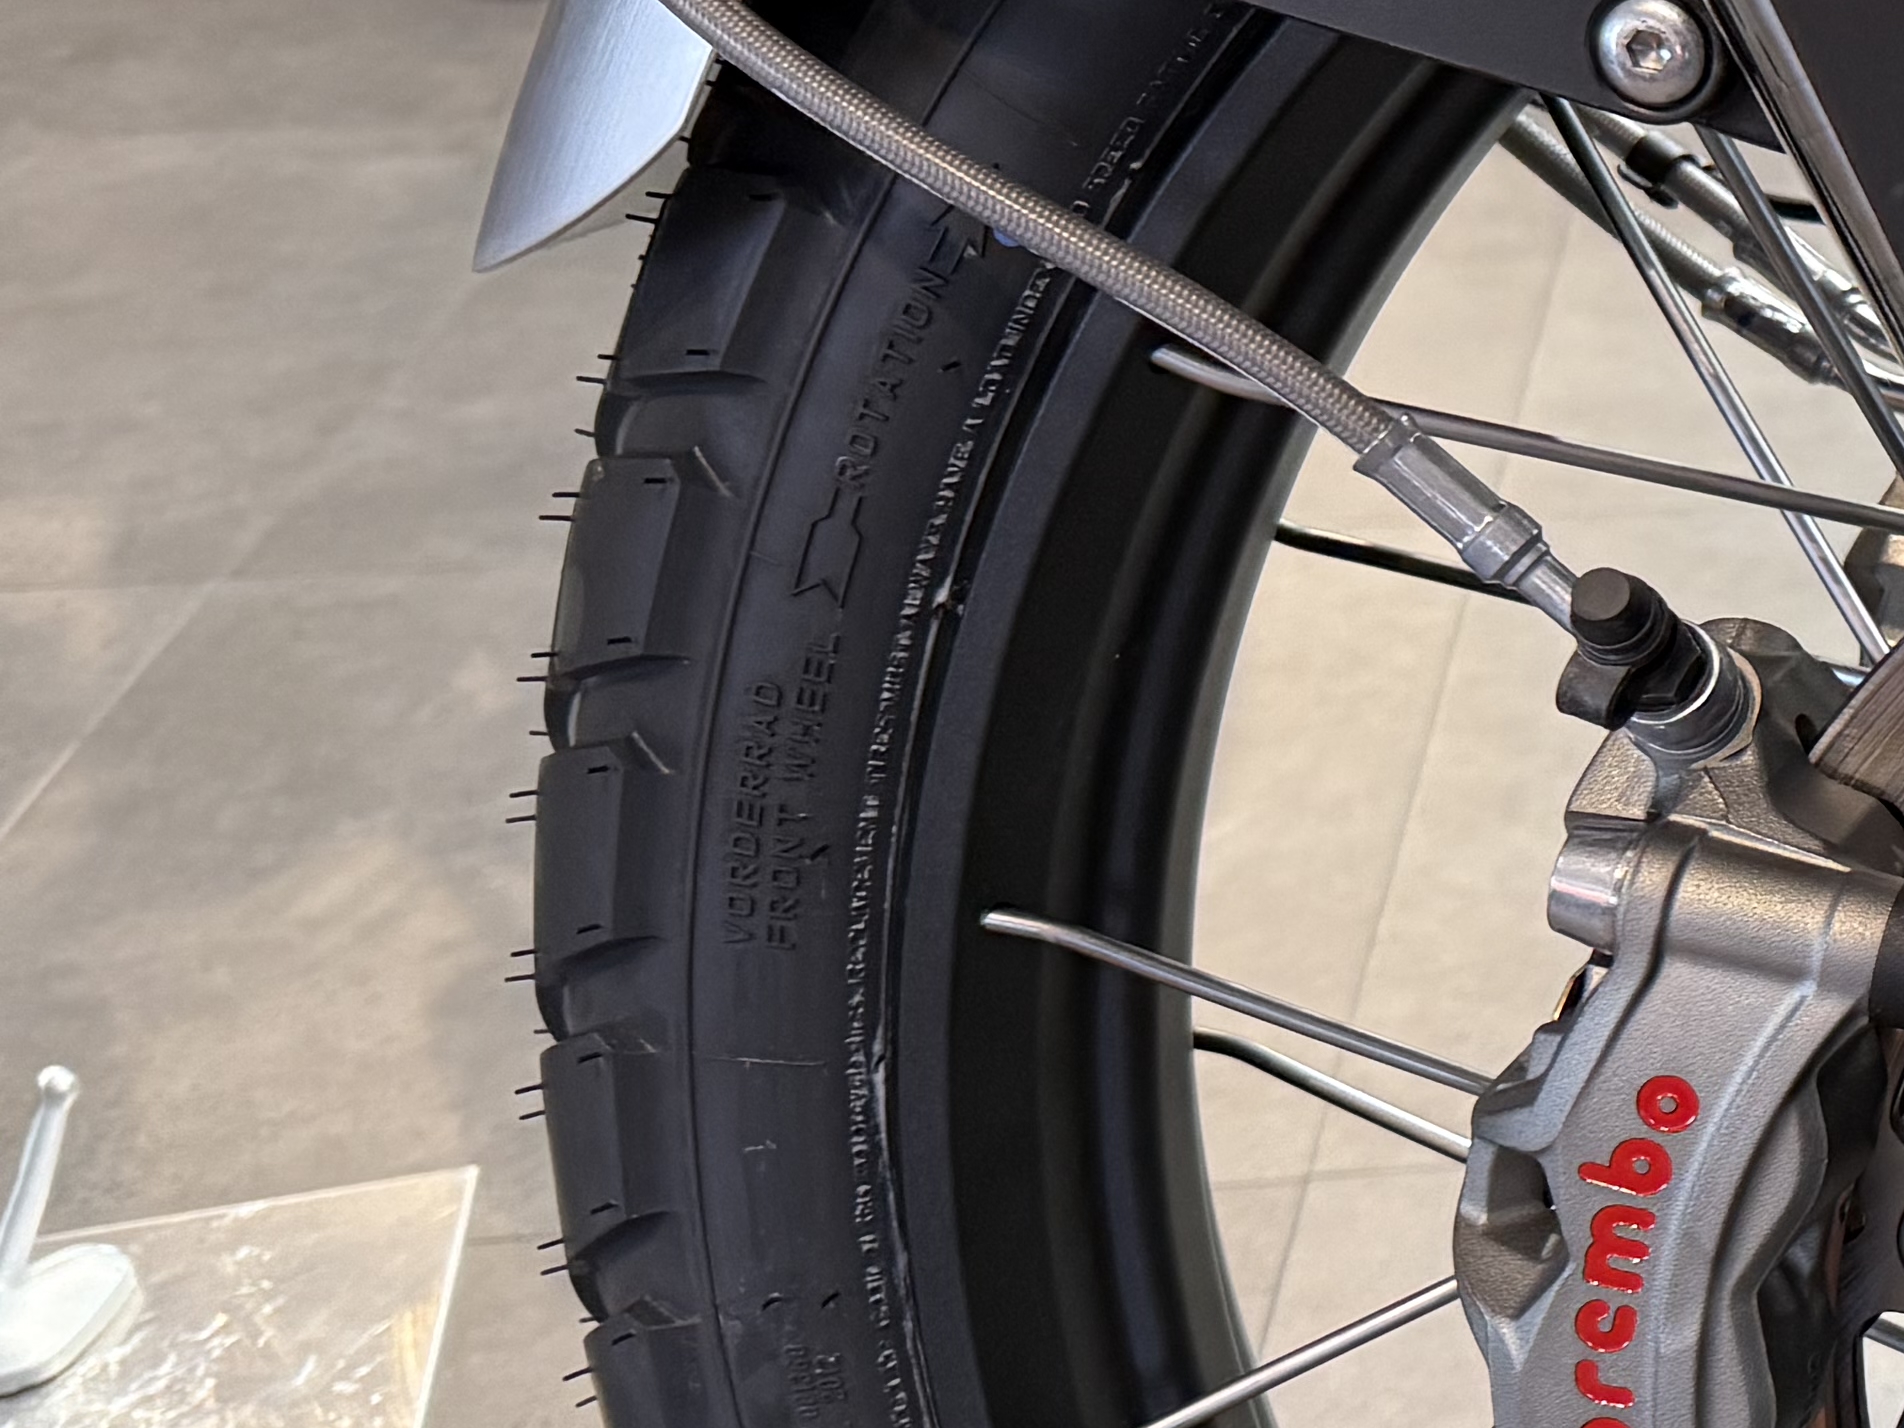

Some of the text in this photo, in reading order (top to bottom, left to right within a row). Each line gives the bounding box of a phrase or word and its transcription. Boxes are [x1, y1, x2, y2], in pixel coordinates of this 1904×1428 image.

[834, 271, 950, 492] ROTATION
[722, 678, 787, 948] VORDERRAD
[765, 630, 843, 951] FRONT WHEEL
